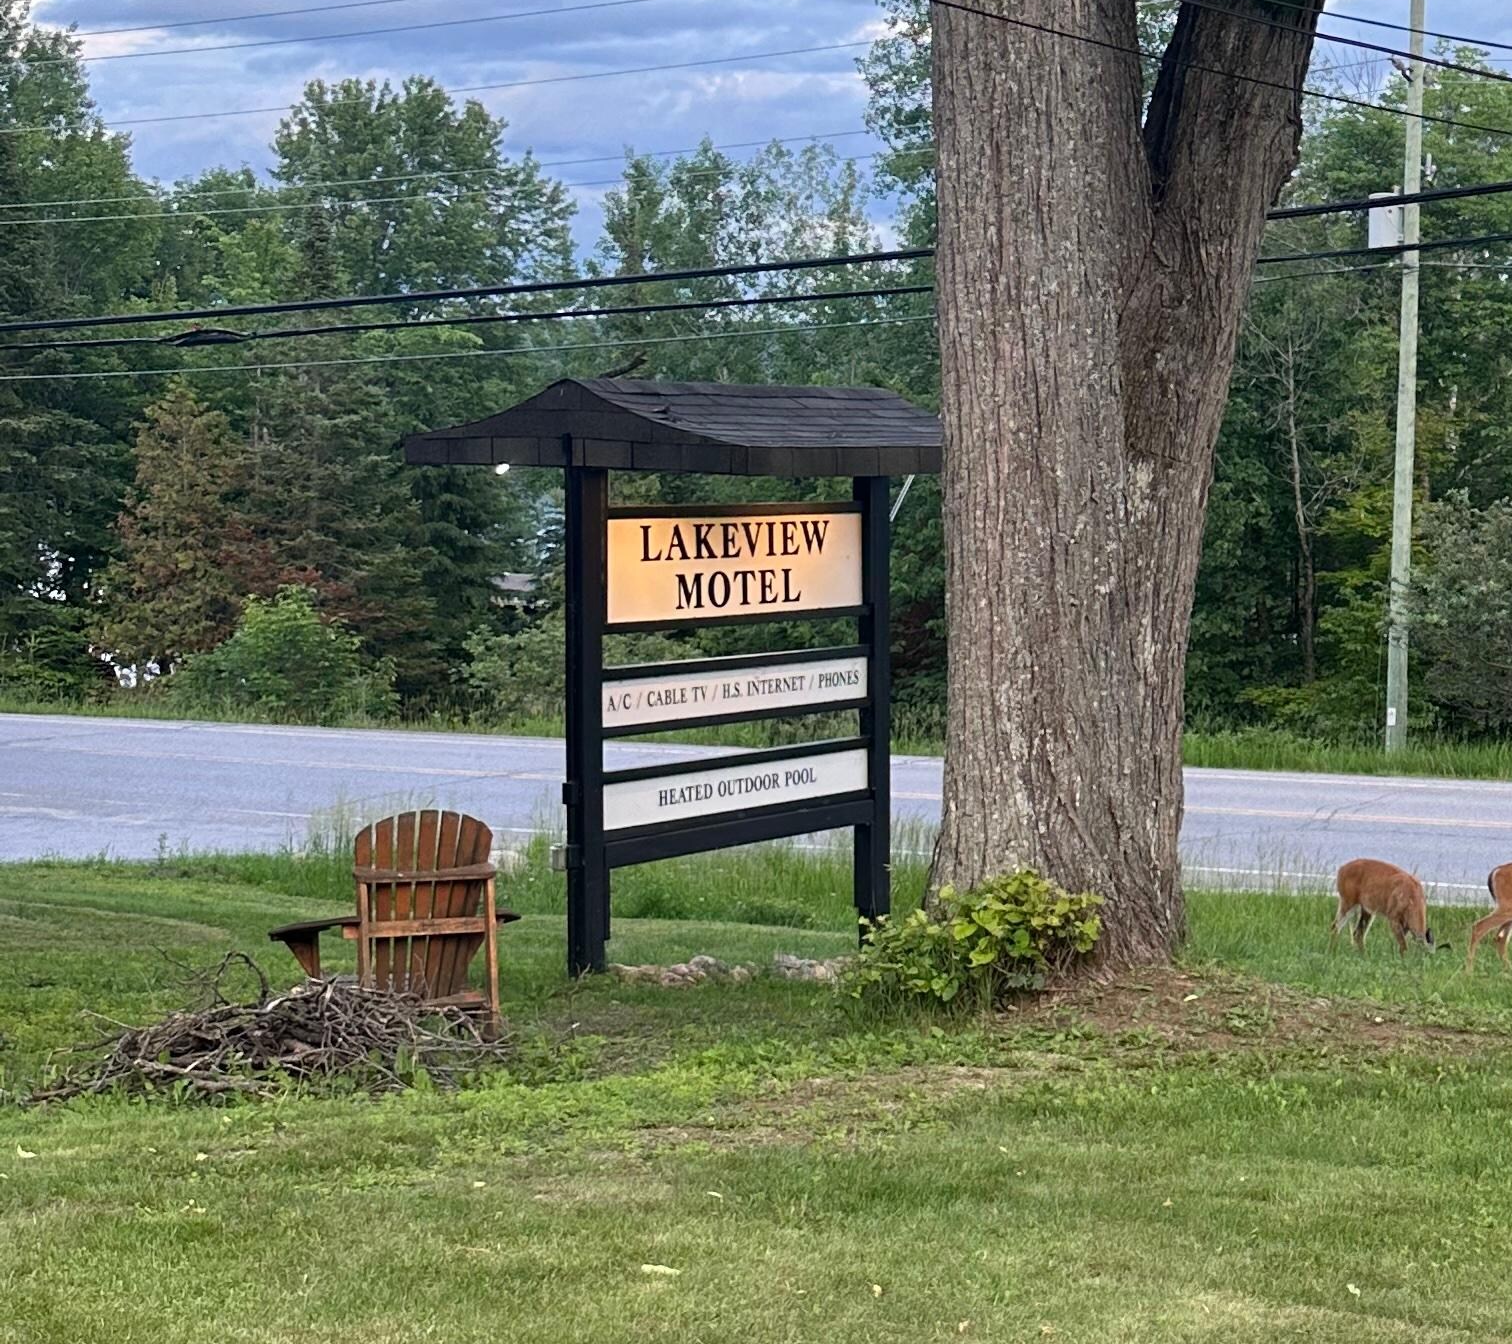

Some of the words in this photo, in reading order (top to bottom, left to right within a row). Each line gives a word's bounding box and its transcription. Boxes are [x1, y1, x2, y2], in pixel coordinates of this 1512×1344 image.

[640, 520, 829, 561] LAKEVIEW
[675, 568, 802, 610] MOTEL
[607, 693, 632, 712] A/C
[647, 687, 688, 707] CABLE
[691, 685, 708, 703] TV
[722, 682, 743, 699] H.S.
[747, 675, 806, 697] INTERNET
[818, 670, 860, 689] PHONES
[658, 783, 714, 807] HEATED
[718, 773, 780, 798] OUTDOOR
[785, 767, 817, 787] POOL
